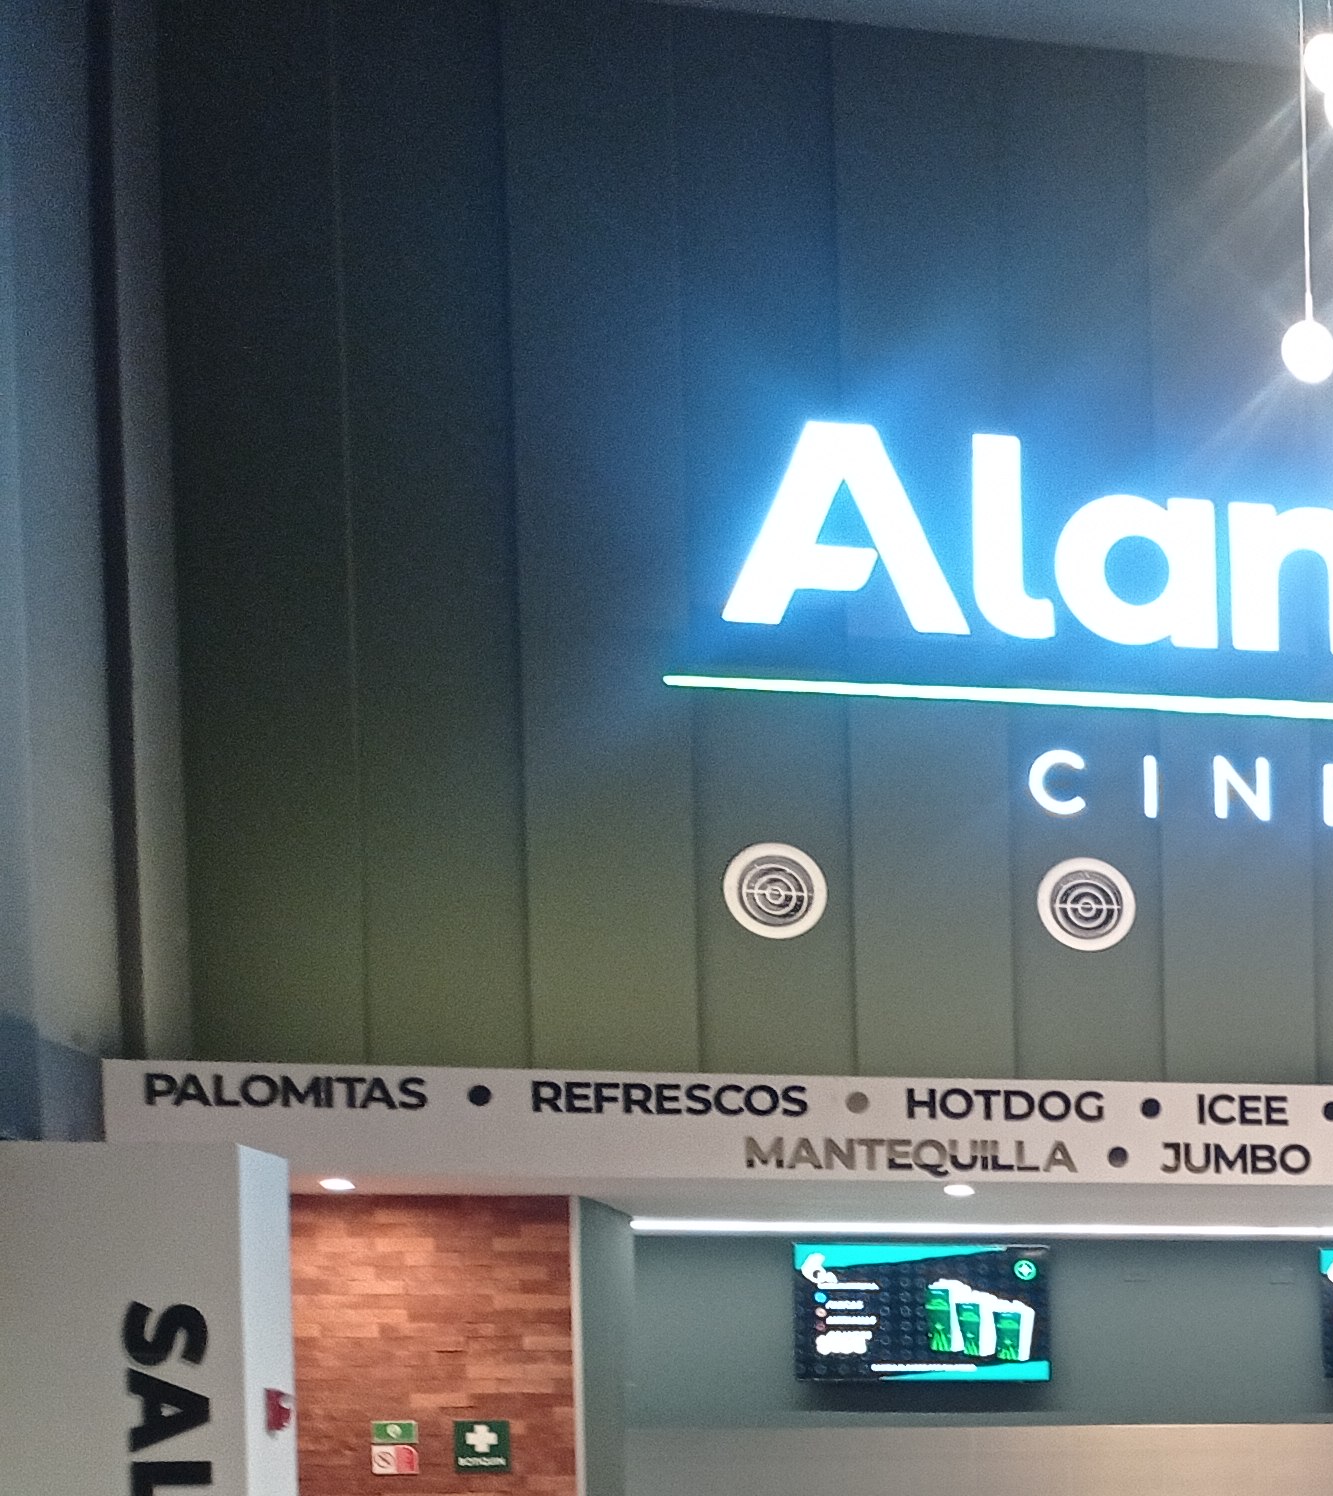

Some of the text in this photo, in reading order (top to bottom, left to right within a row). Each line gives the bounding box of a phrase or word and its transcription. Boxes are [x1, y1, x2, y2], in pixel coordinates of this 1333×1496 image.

[143, 1072, 428, 1111] PALOMITAS
[530, 1080, 809, 1118] REFRESCOS
[905, 1087, 1106, 1123] HOTDOG
[1196, 1092, 1289, 1127] ICEE
[744, 1135, 1079, 1177] MANTEQUILLA
[1160, 1141, 1312, 1176] JUMBO
